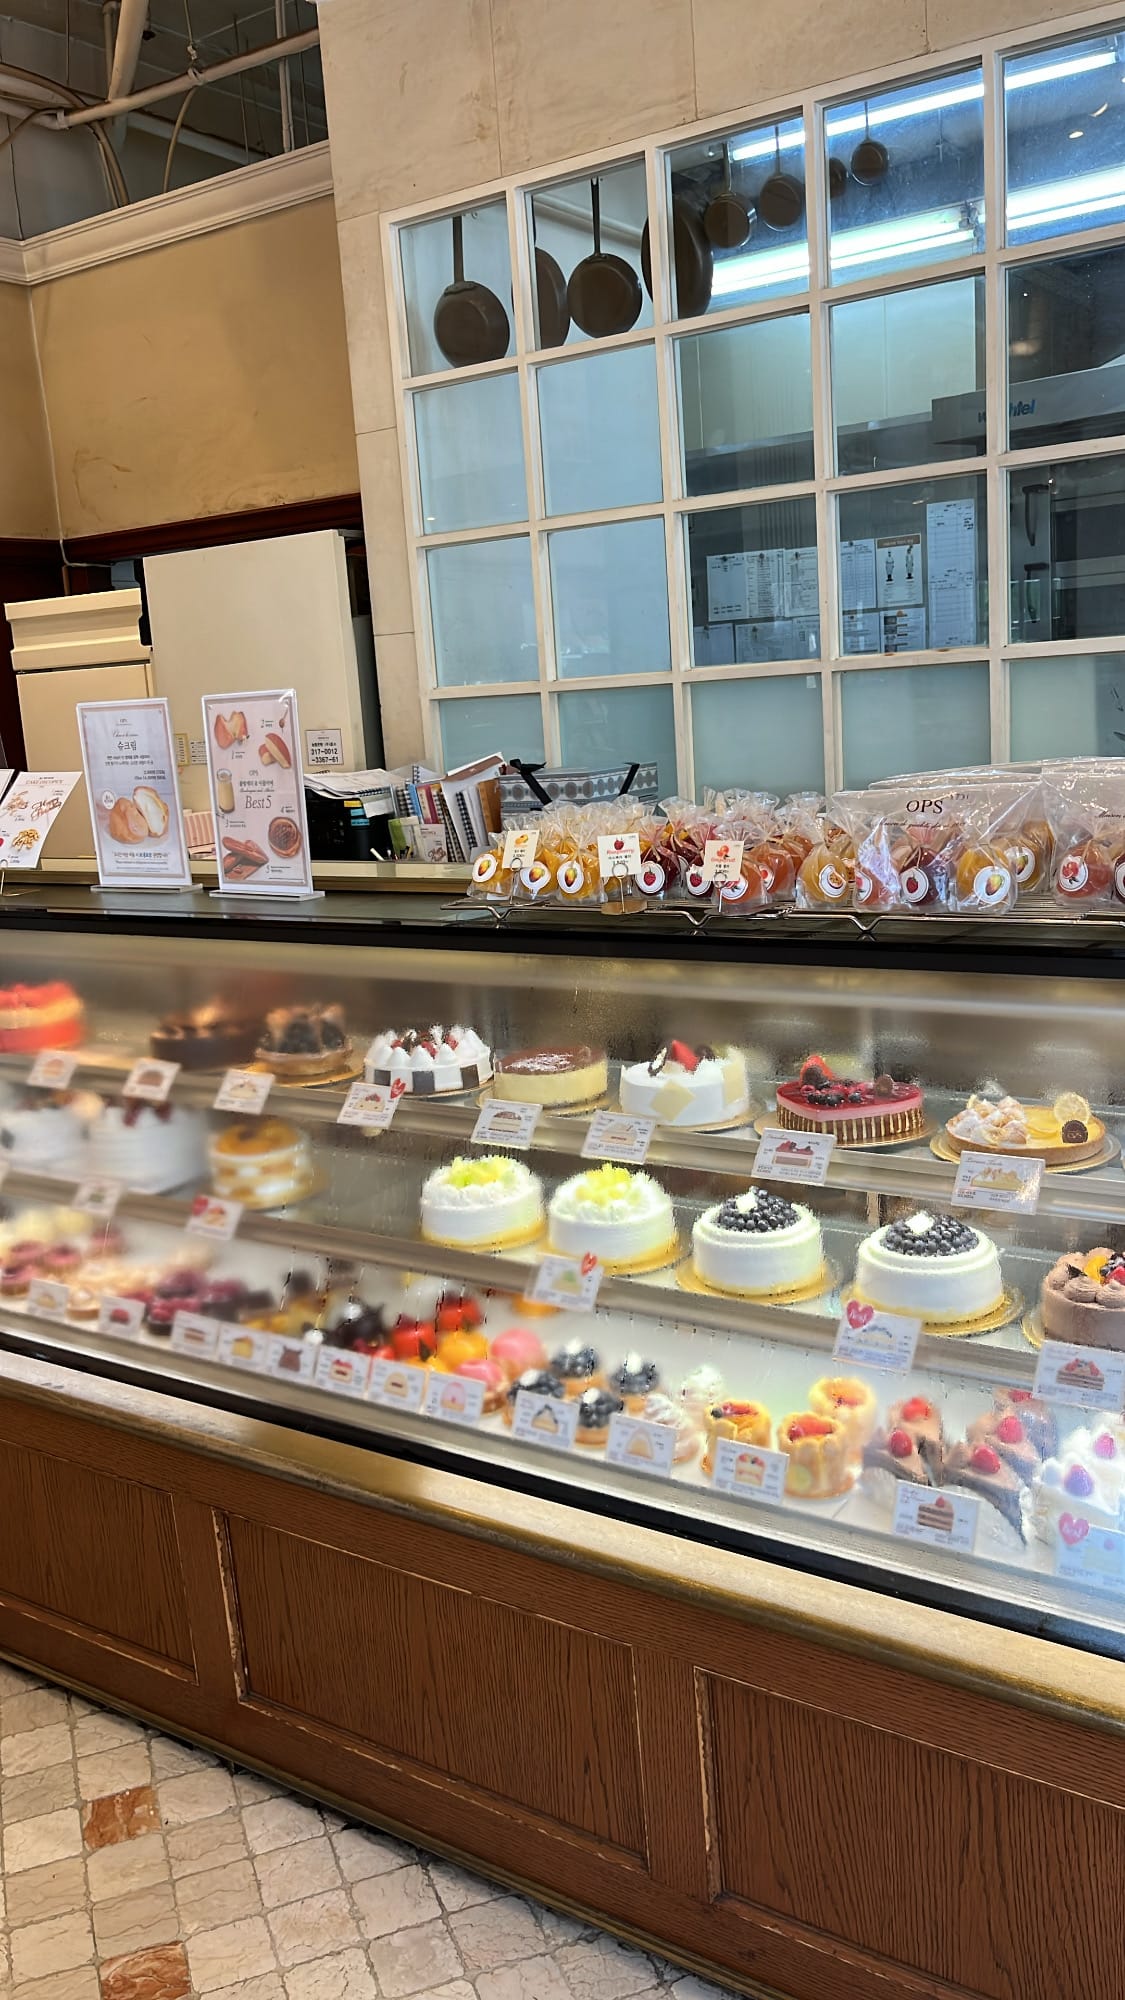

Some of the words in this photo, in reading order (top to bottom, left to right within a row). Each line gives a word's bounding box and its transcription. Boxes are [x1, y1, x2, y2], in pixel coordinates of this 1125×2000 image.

[117, 740, 137, 751] 슈크림
[245, 795, 265, 809] Best
[265, 795, 272, 809] 5
[905, 799, 943, 815] OPS
